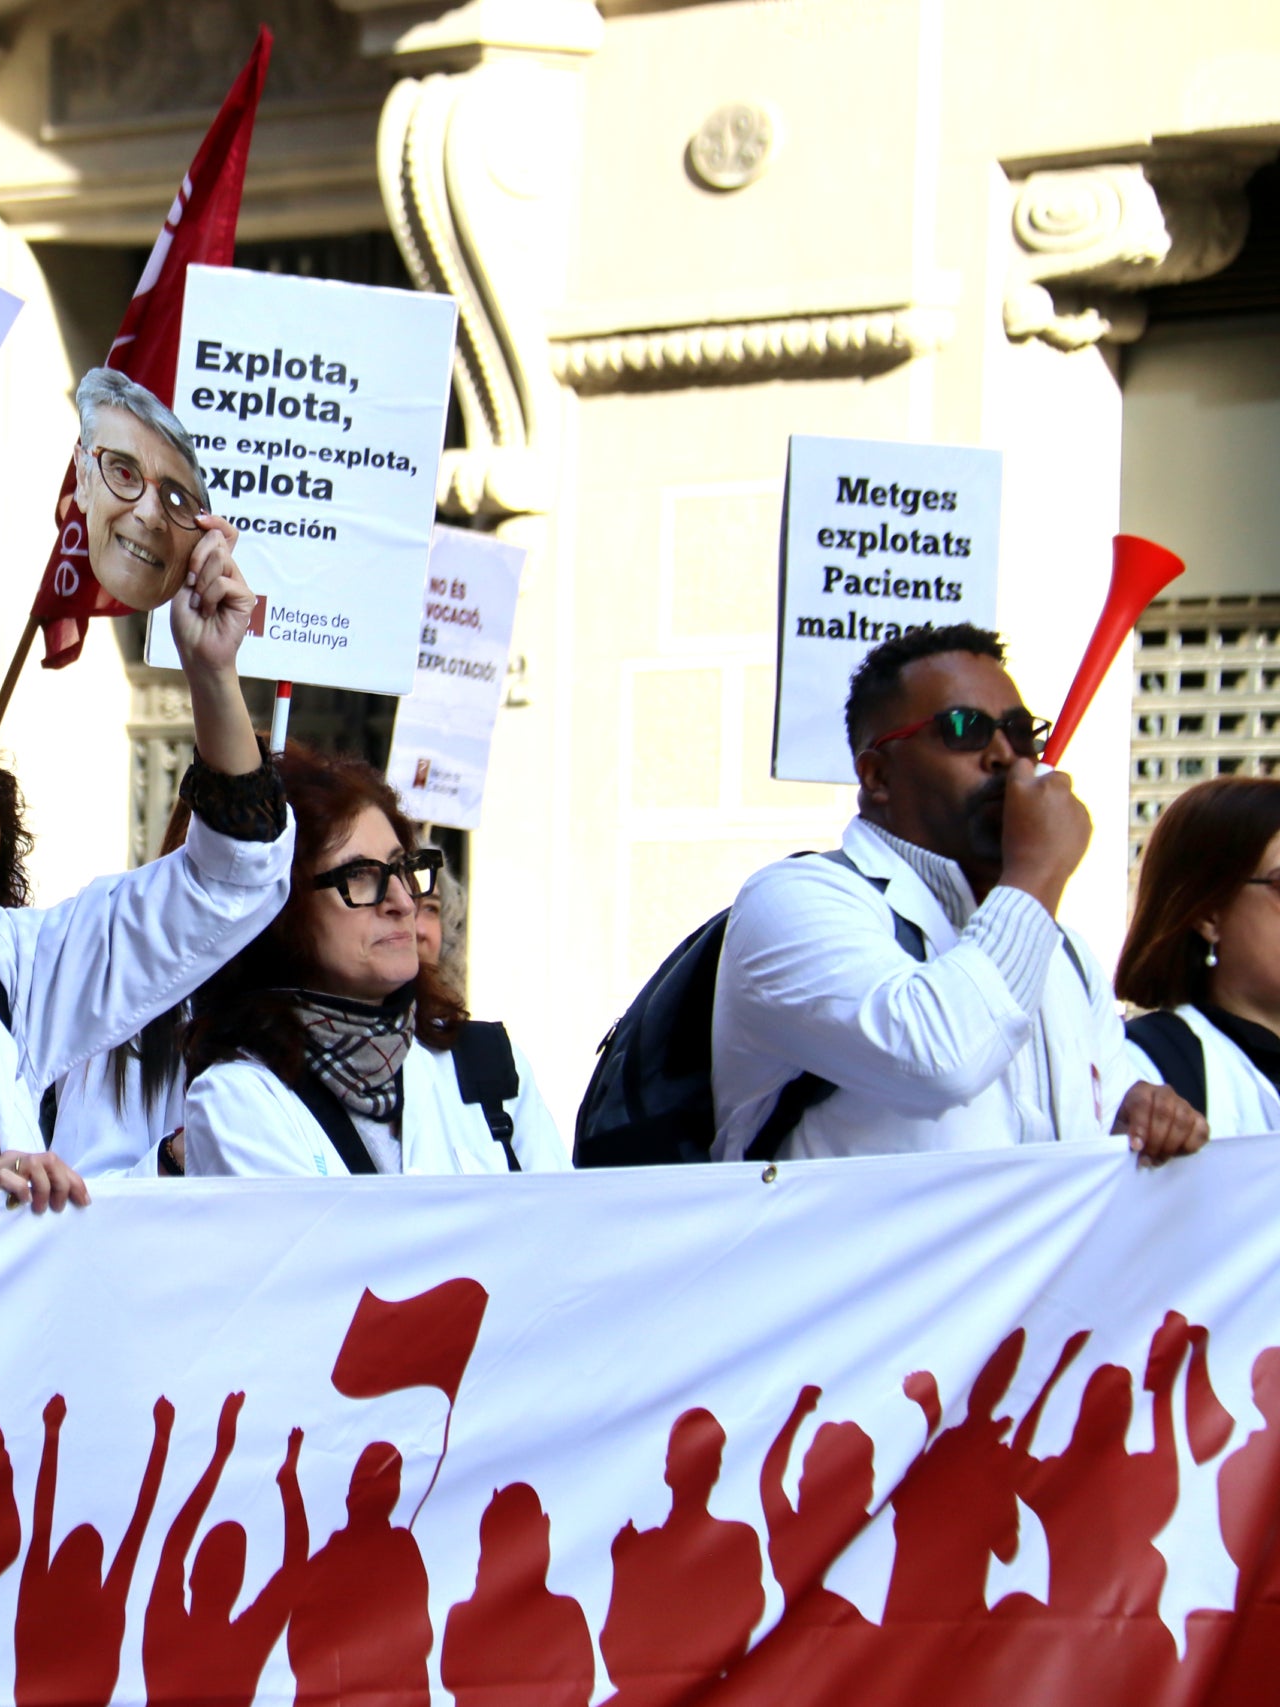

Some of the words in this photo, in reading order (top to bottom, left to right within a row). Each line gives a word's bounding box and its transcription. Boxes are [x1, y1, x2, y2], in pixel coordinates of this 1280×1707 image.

[195, 340, 359, 394] Explota,
[191, 386, 353, 432] explota,
[236, 438, 418, 476] explo-explota,
[199, 464, 334, 501] xplota
[835, 477, 958, 515] Metges
[816, 523, 972, 558] explotats
[822, 566, 963, 602] Pacients
[270, 606, 328, 628] Metges
[331, 613, 350, 629] de
[425, 603, 483, 632] VOCACIÓ,
[796, 611, 944, 642] maltra
[269, 625, 348, 650] Catalunya
